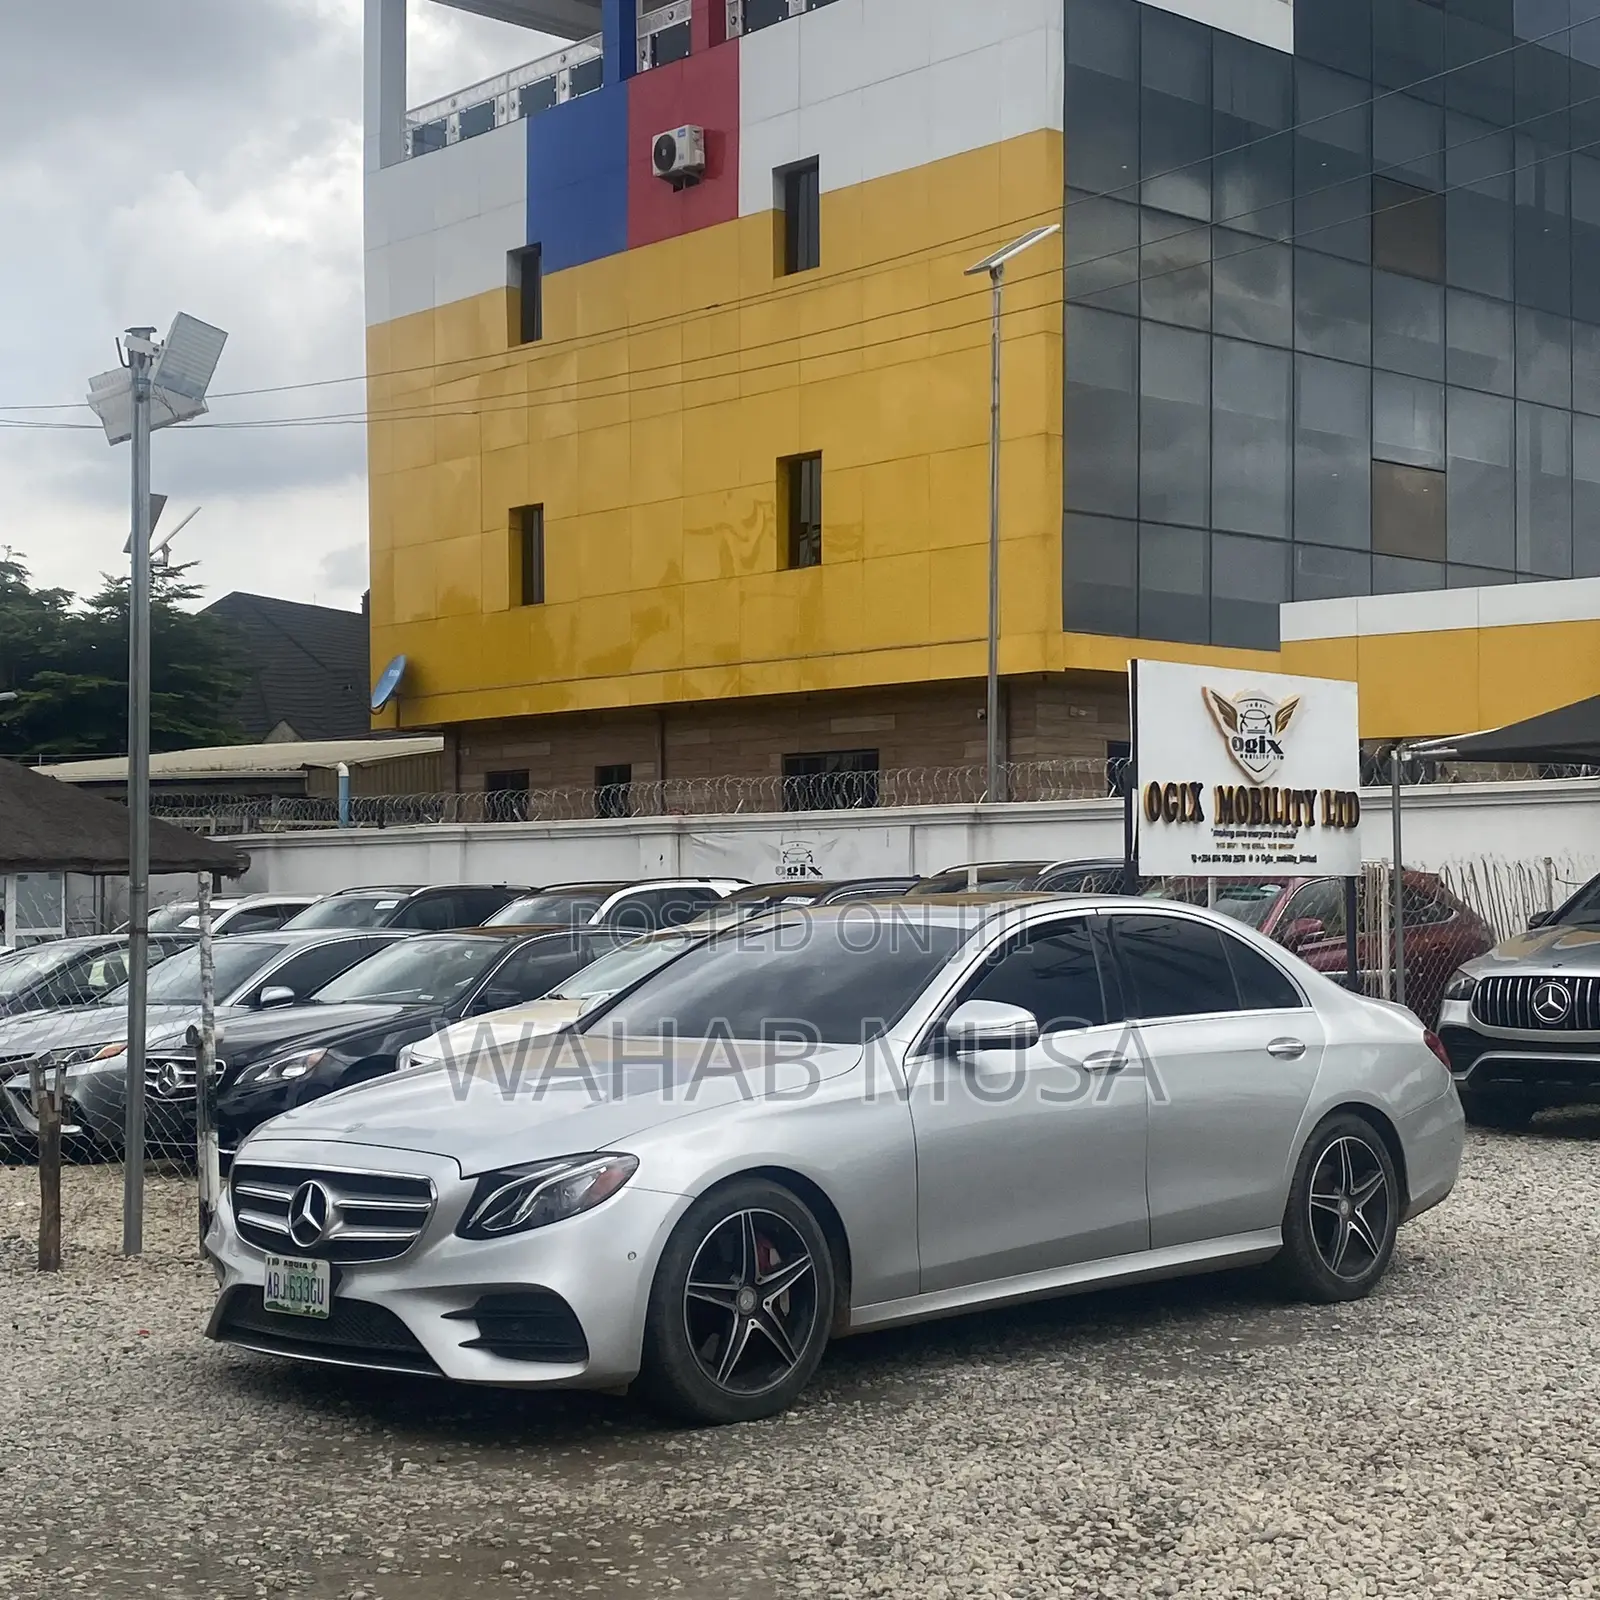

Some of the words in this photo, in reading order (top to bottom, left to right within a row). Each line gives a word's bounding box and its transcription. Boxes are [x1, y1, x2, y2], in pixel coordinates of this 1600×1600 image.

[1144, 781, 1204, 823] OGIX
[1214, 785, 1317, 828] MOBILITY
[1320, 789, 1360, 829] LTD
